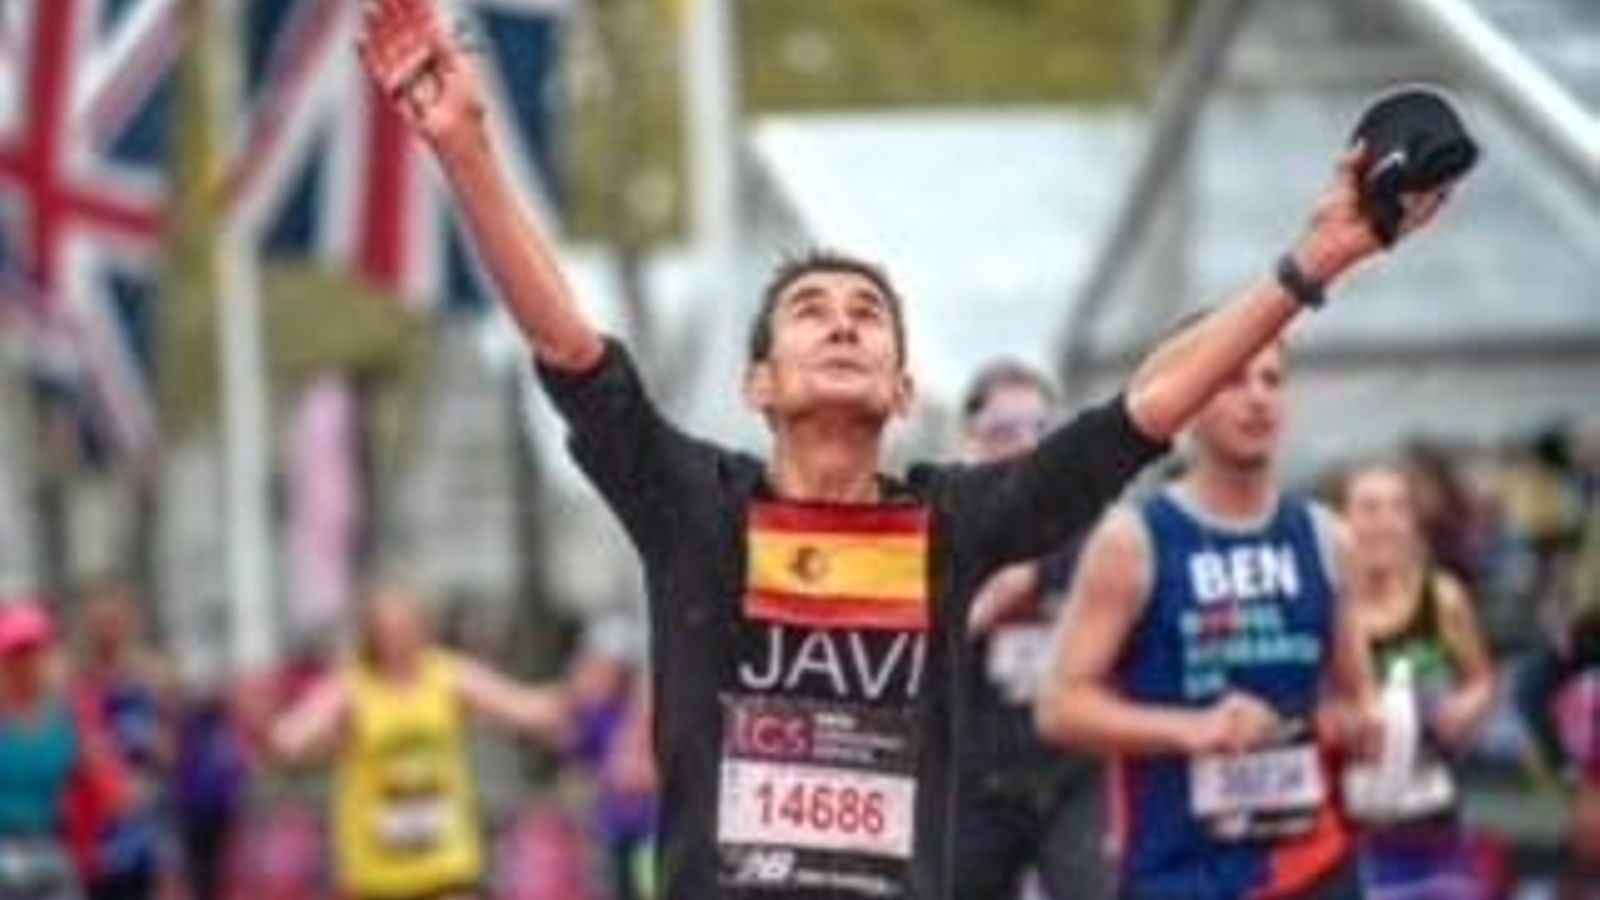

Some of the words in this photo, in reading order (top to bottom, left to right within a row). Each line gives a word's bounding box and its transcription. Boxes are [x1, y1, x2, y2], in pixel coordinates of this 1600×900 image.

[1189, 546, 1300, 602] BEN
[739, 628, 926, 698] JAVI
[756, 781, 885, 836] 14686
